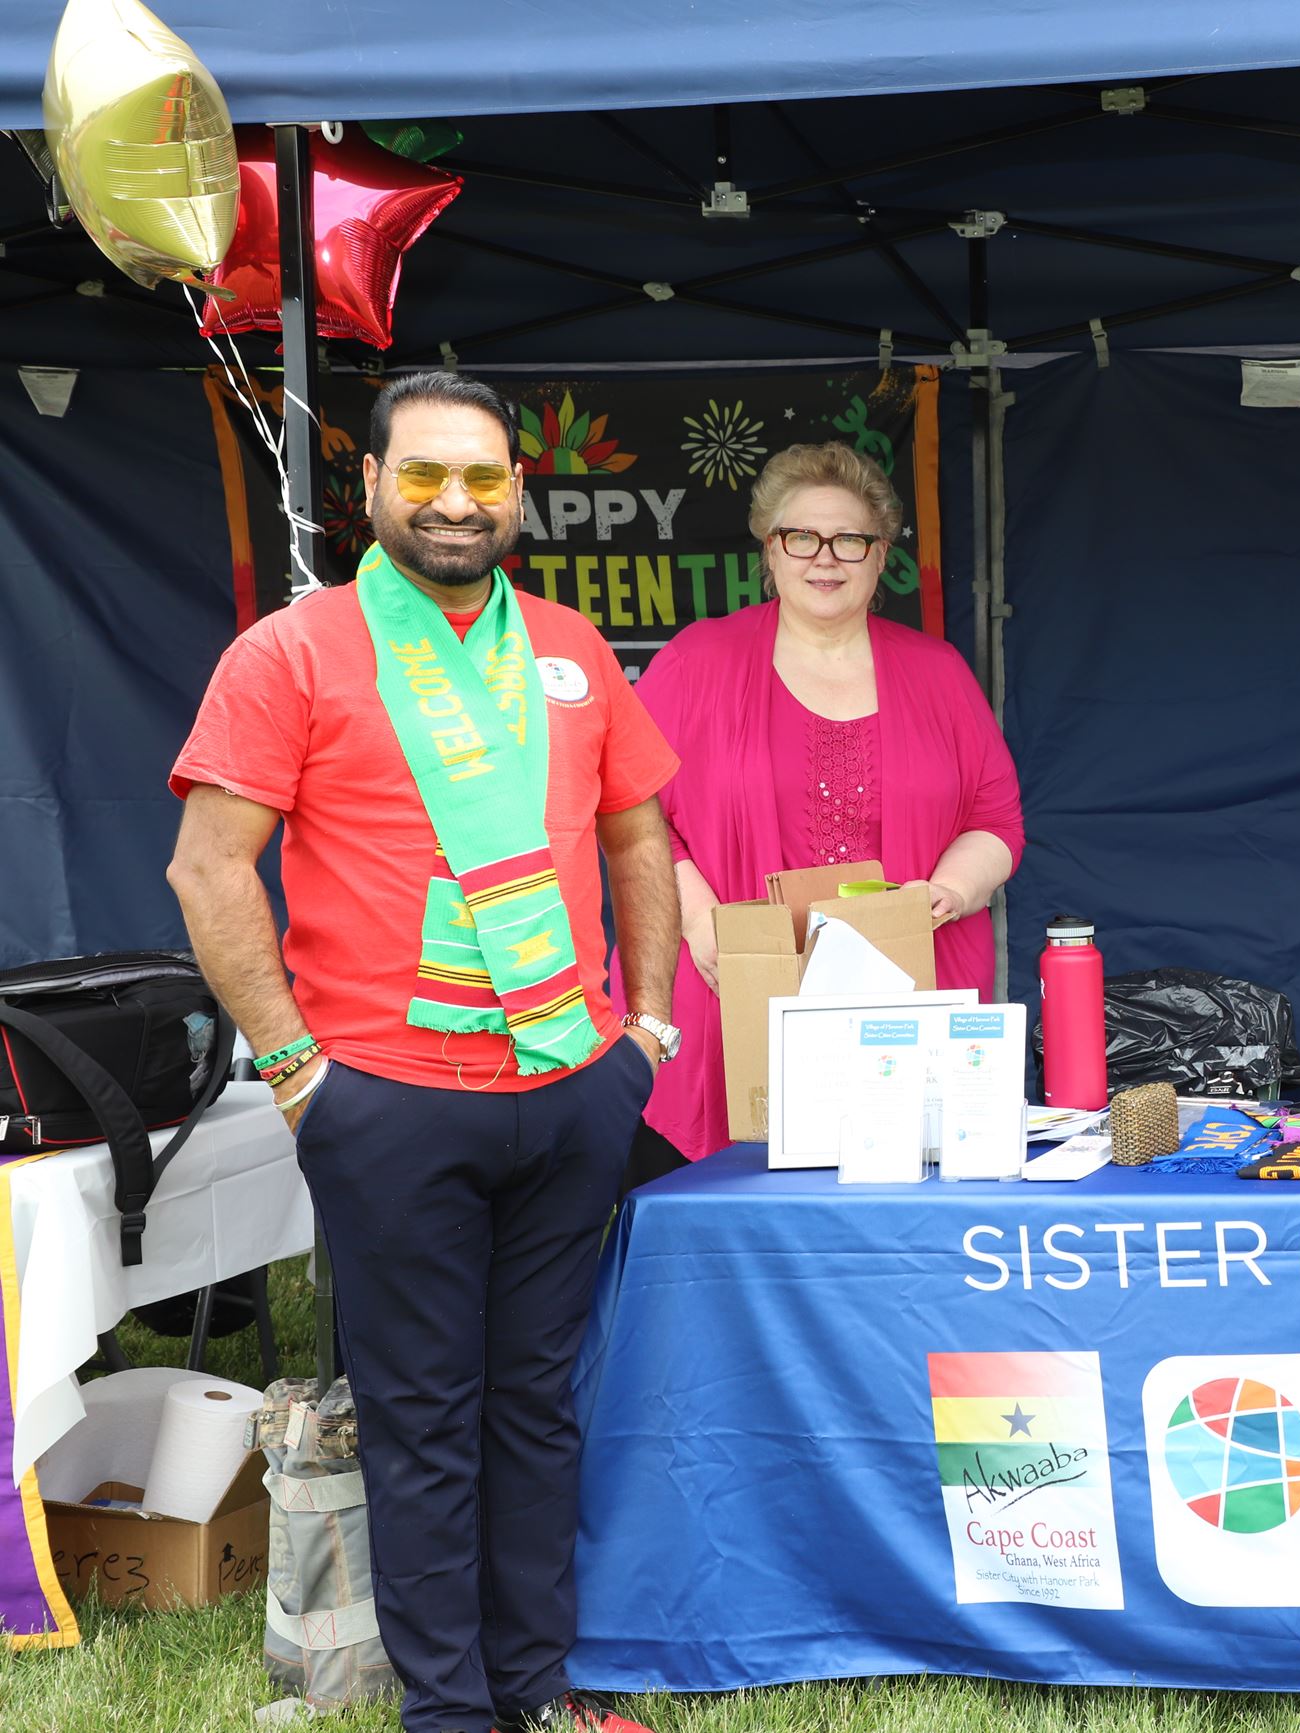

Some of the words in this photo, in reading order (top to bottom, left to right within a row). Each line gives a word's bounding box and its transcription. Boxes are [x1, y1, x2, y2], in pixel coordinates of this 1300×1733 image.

[520, 488, 687, 541] APPY
[388, 635, 496, 782] WELCOME
[961, 1220, 1273, 1292] SISTER
[962, 1442, 1088, 1514] Akwaaba
[966, 1521, 1024, 1555] Cape
[1031, 1522, 1098, 1549] Coast
[1005, 1553, 1041, 1568] Ghana,
[1042, 1554, 1068, 1567] West
[1069, 1554, 1101, 1567] Africa
[51, 1549, 150, 1594] erez
[976, 1569, 1001, 1581] Sister
[1001, 1572, 1020, 1587] City
[1020, 1572, 1039, 1585] with
[1040, 1574, 1078, 1587] Hanover
[1079, 1575, 1100, 1587] Park
[1017, 1585, 1040, 1597] Since
[1041, 1587, 1061, 1599] 1992
